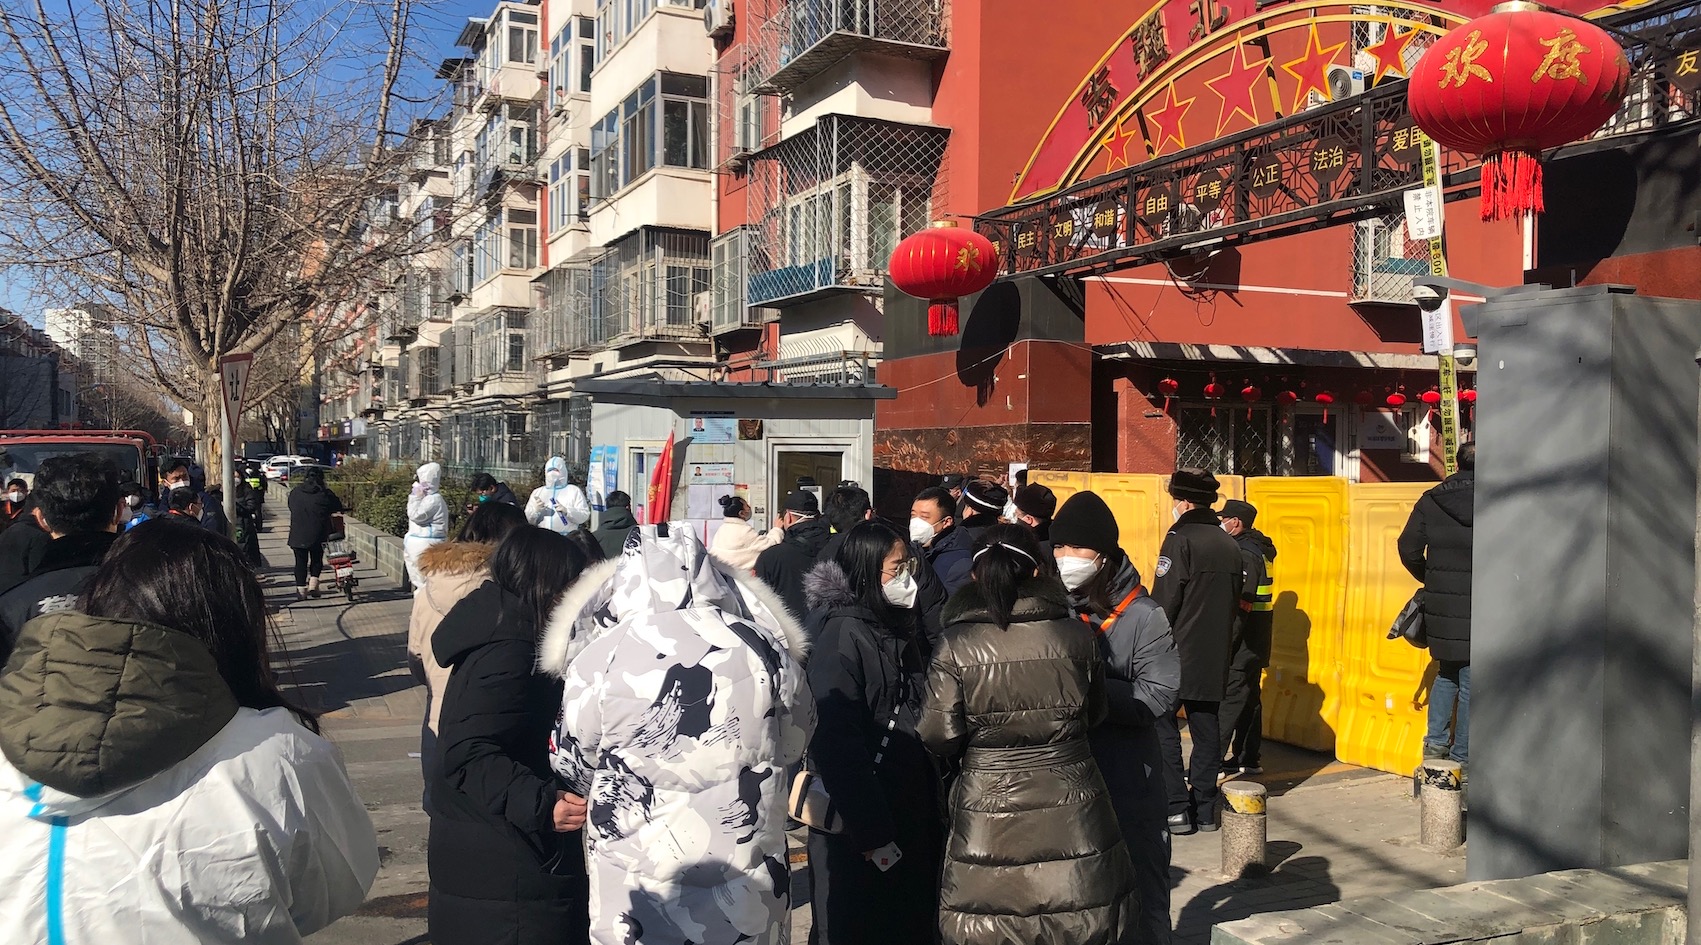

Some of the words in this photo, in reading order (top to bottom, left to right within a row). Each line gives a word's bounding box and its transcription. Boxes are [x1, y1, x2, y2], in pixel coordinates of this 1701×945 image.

[1438, 27, 1592, 89] 欢度
[1675, 50, 1700, 77] 友
[1392, 125, 1421, 152] 爱国
[1313, 145, 1344, 171] 法治
[1253, 163, 1279, 188] 公正
[1196, 180, 1222, 203] 平等
[1145, 194, 1168, 216] 自由
[1412, 193, 1425, 237] 禁止入内
[1053, 219, 1073, 239] 文明
[1094, 208, 1115, 230] 和谐
[1017, 230, 1035, 250] 民主
